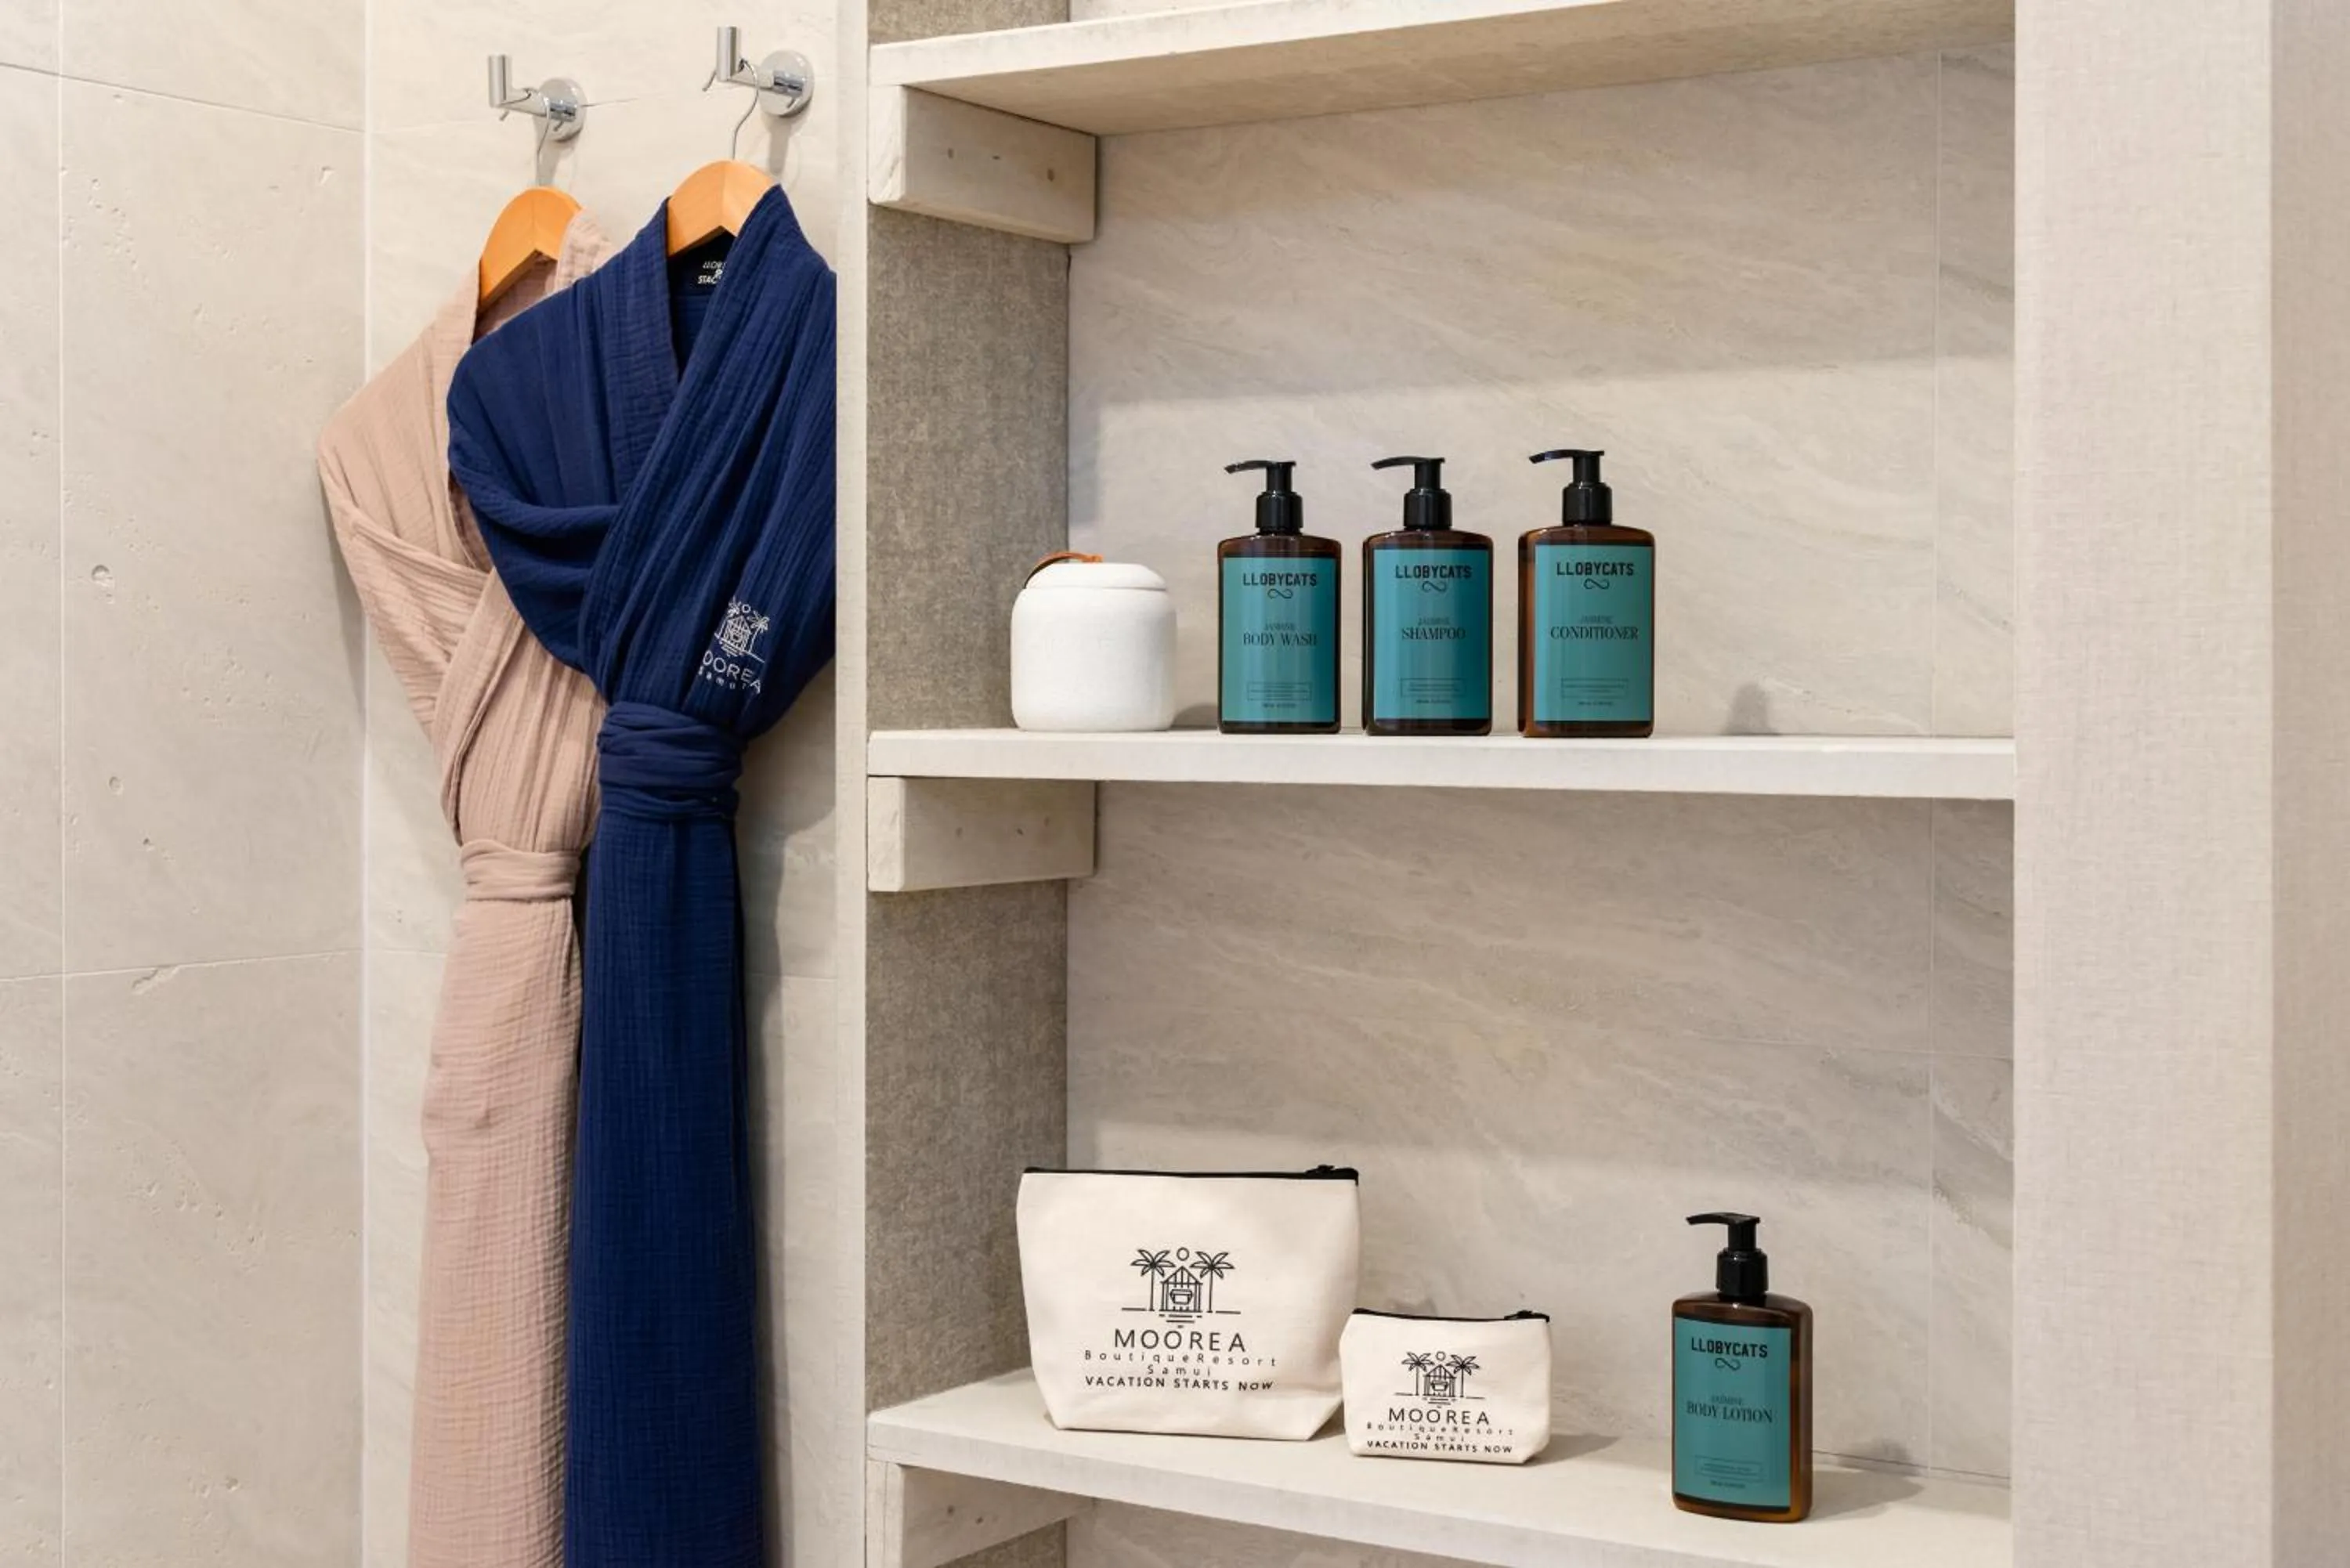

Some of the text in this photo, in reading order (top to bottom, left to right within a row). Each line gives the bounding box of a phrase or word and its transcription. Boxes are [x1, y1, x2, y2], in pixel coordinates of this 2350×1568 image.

[697, 275, 721, 284] STAC
[1395, 565, 1473, 579] LLOBYCATS
[1556, 562, 1634, 576] LLOBYCATS
[1243, 573, 1318, 587] LLOBYCATS
[1243, 633, 1318, 647] BODY WASH
[1401, 627, 1466, 640] SHAMPOO
[1550, 626, 1639, 640] CONDITIONER
[703, 650, 761, 694] OOREA
[1115, 1328, 1246, 1353] MOOREA
[1691, 1337, 1768, 1358] LLOBYCATS
[1147, 1364, 1211, 1376] Samui
[1085, 1376, 1274, 1392] VACATION STARTS NOW
[1389, 1407, 1490, 1425] MOOREA
[1687, 1400, 1773, 1424] BODY LOTION
[1413, 1433, 1465, 1442] Samui
[1367, 1440, 1513, 1454] VACATION STARTS NOW
